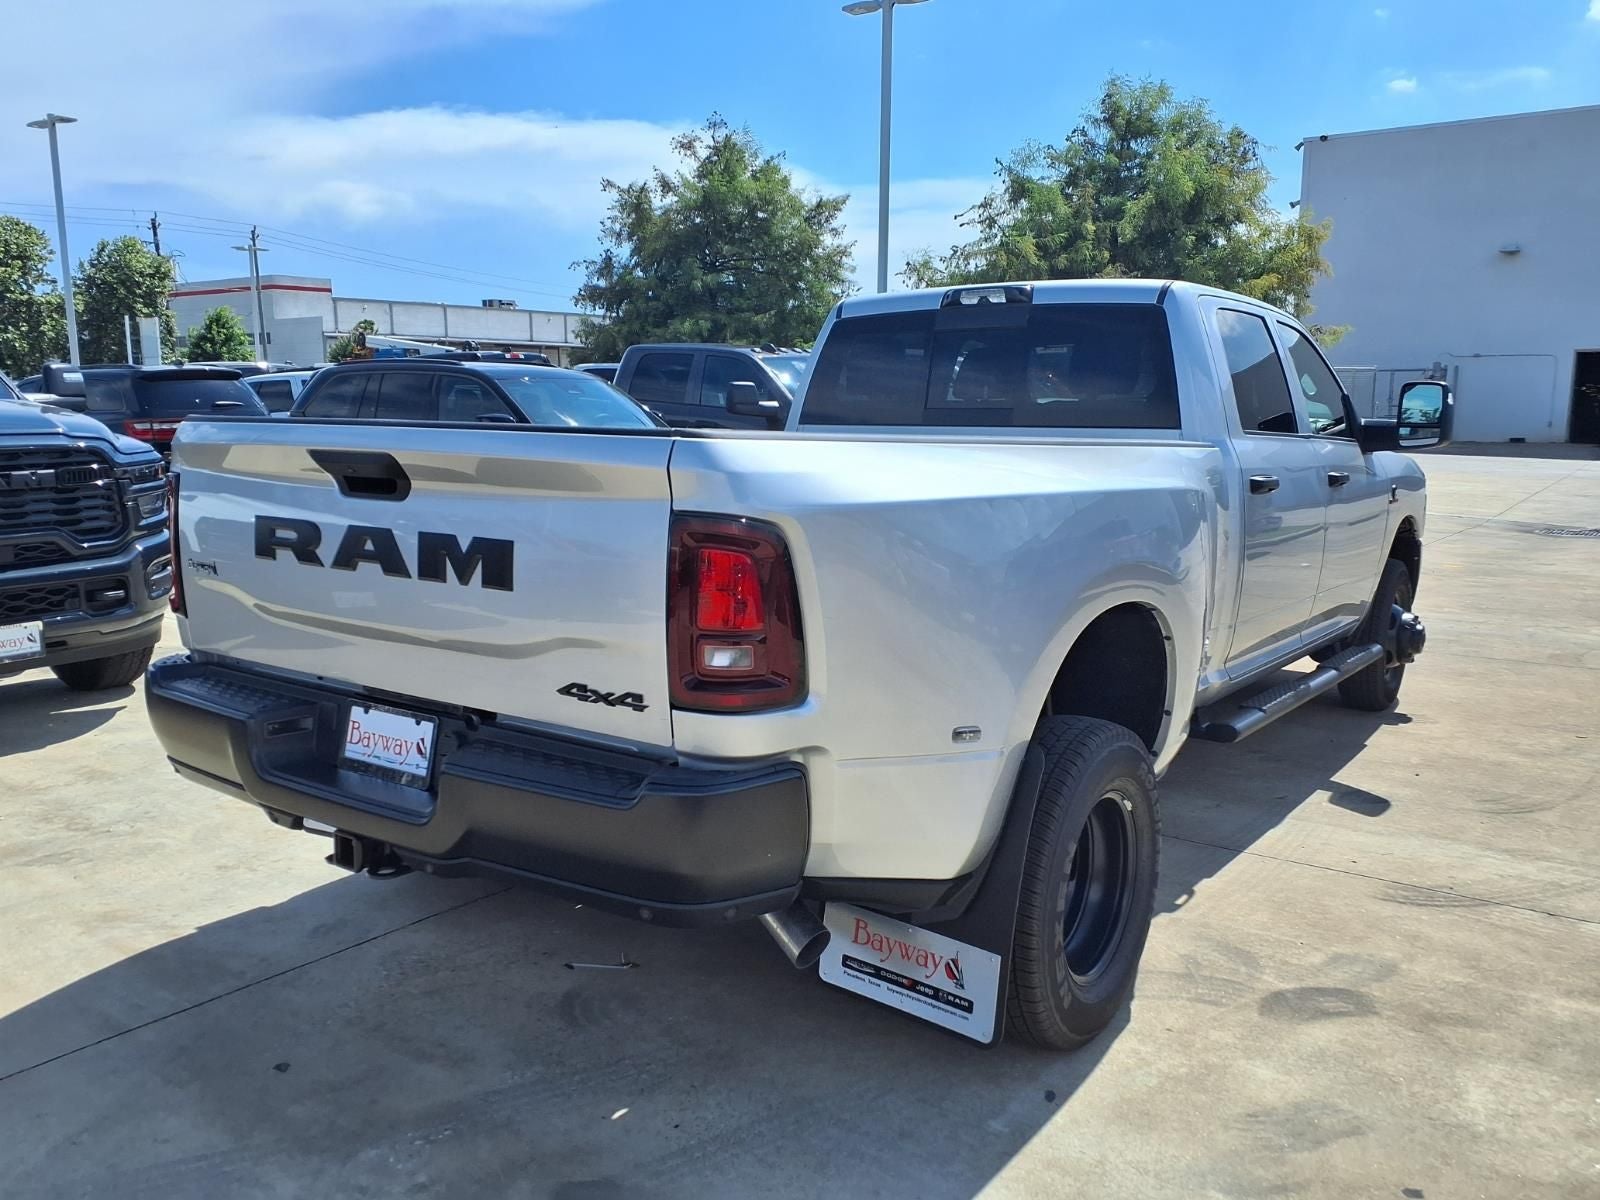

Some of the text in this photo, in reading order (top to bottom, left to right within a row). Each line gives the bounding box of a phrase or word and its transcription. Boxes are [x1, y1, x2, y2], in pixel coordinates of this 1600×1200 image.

[254, 514, 514, 592] RAM
[347, 719, 414, 766] Bayway
[851, 917, 944, 979] Bayway
